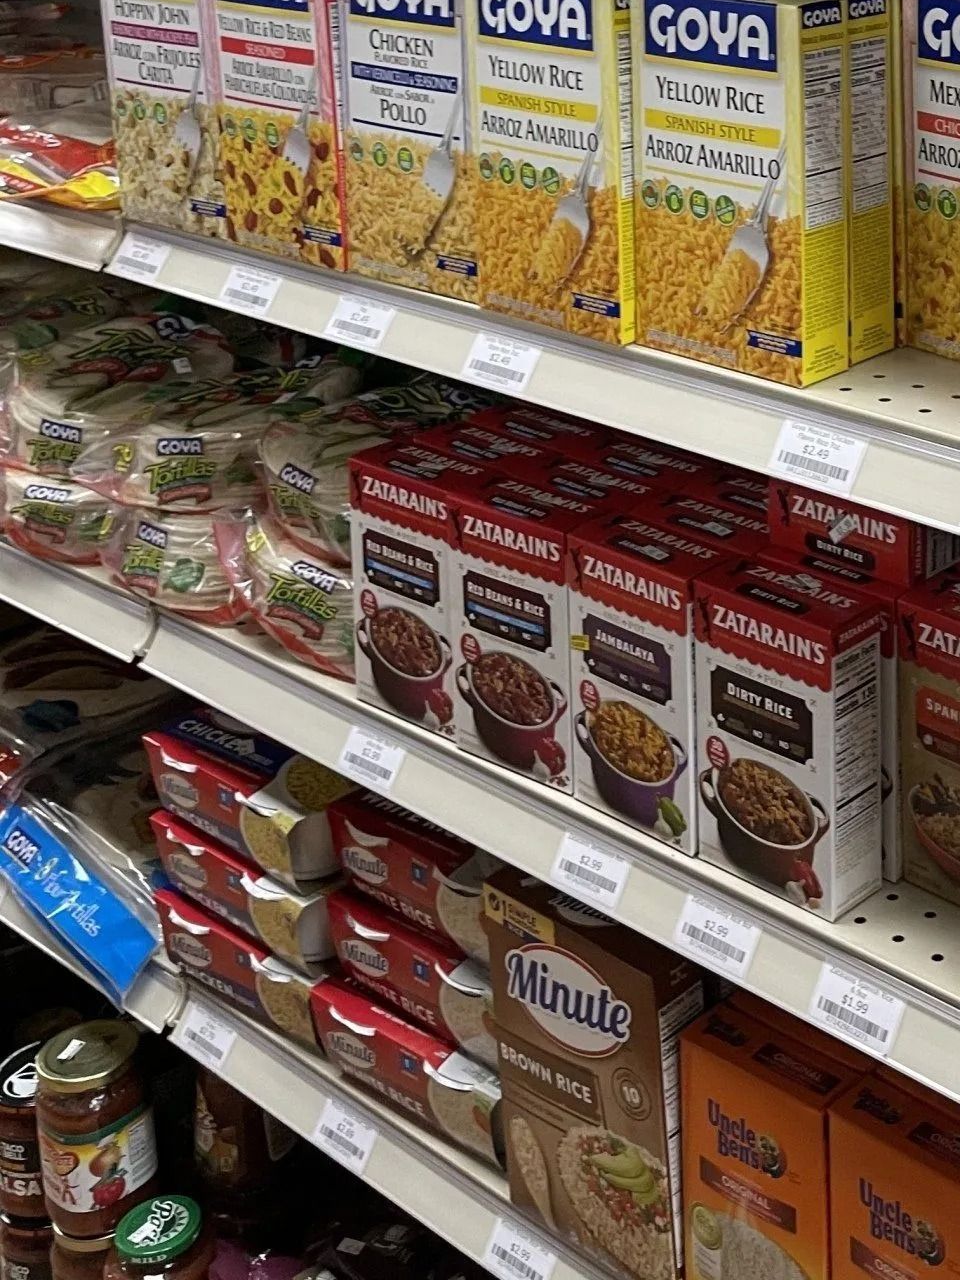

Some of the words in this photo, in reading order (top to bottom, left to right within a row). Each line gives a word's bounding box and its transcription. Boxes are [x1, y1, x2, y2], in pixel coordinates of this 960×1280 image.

[649, 3, 772, 61] GOYA
[488, 54, 546, 85] YELLOW
[549, 64, 584, 91] RICE
[656, 75, 721, 109] YELLOW
[727, 85, 765, 114] RICE
[380, 99, 427, 125] POLLO
[665, 115, 716, 137] SPANISH
[719, 124, 757, 143] STYLE
[646, 134, 694, 164] ARROZ
[697, 142, 781, 181] AMARILLO
[158, 440, 203, 454] GOYA
[802, 444, 830, 460] $2.49
[363, 475, 448, 521] ZATARAIN'S
[463, 515, 562, 563] ZATARAIN'S
[583, 555, 684, 611] ZATARAIN'S
[595, 629, 655, 665] JAMBALAYA
[712, 604, 827, 665] ZATARAIN'S
[727, 681, 761, 709] DIRTY
[764, 694, 794, 720] RICE
[507, 951, 629, 1041] Minute
[500, 1041, 552, 1087] BROWN
[555, 1072, 593, 1104] RICE
[622, 1085, 640, 1104] 10
[707, 1098, 757, 1149] Uncle
[859, 1177, 914, 1233] Uncle
